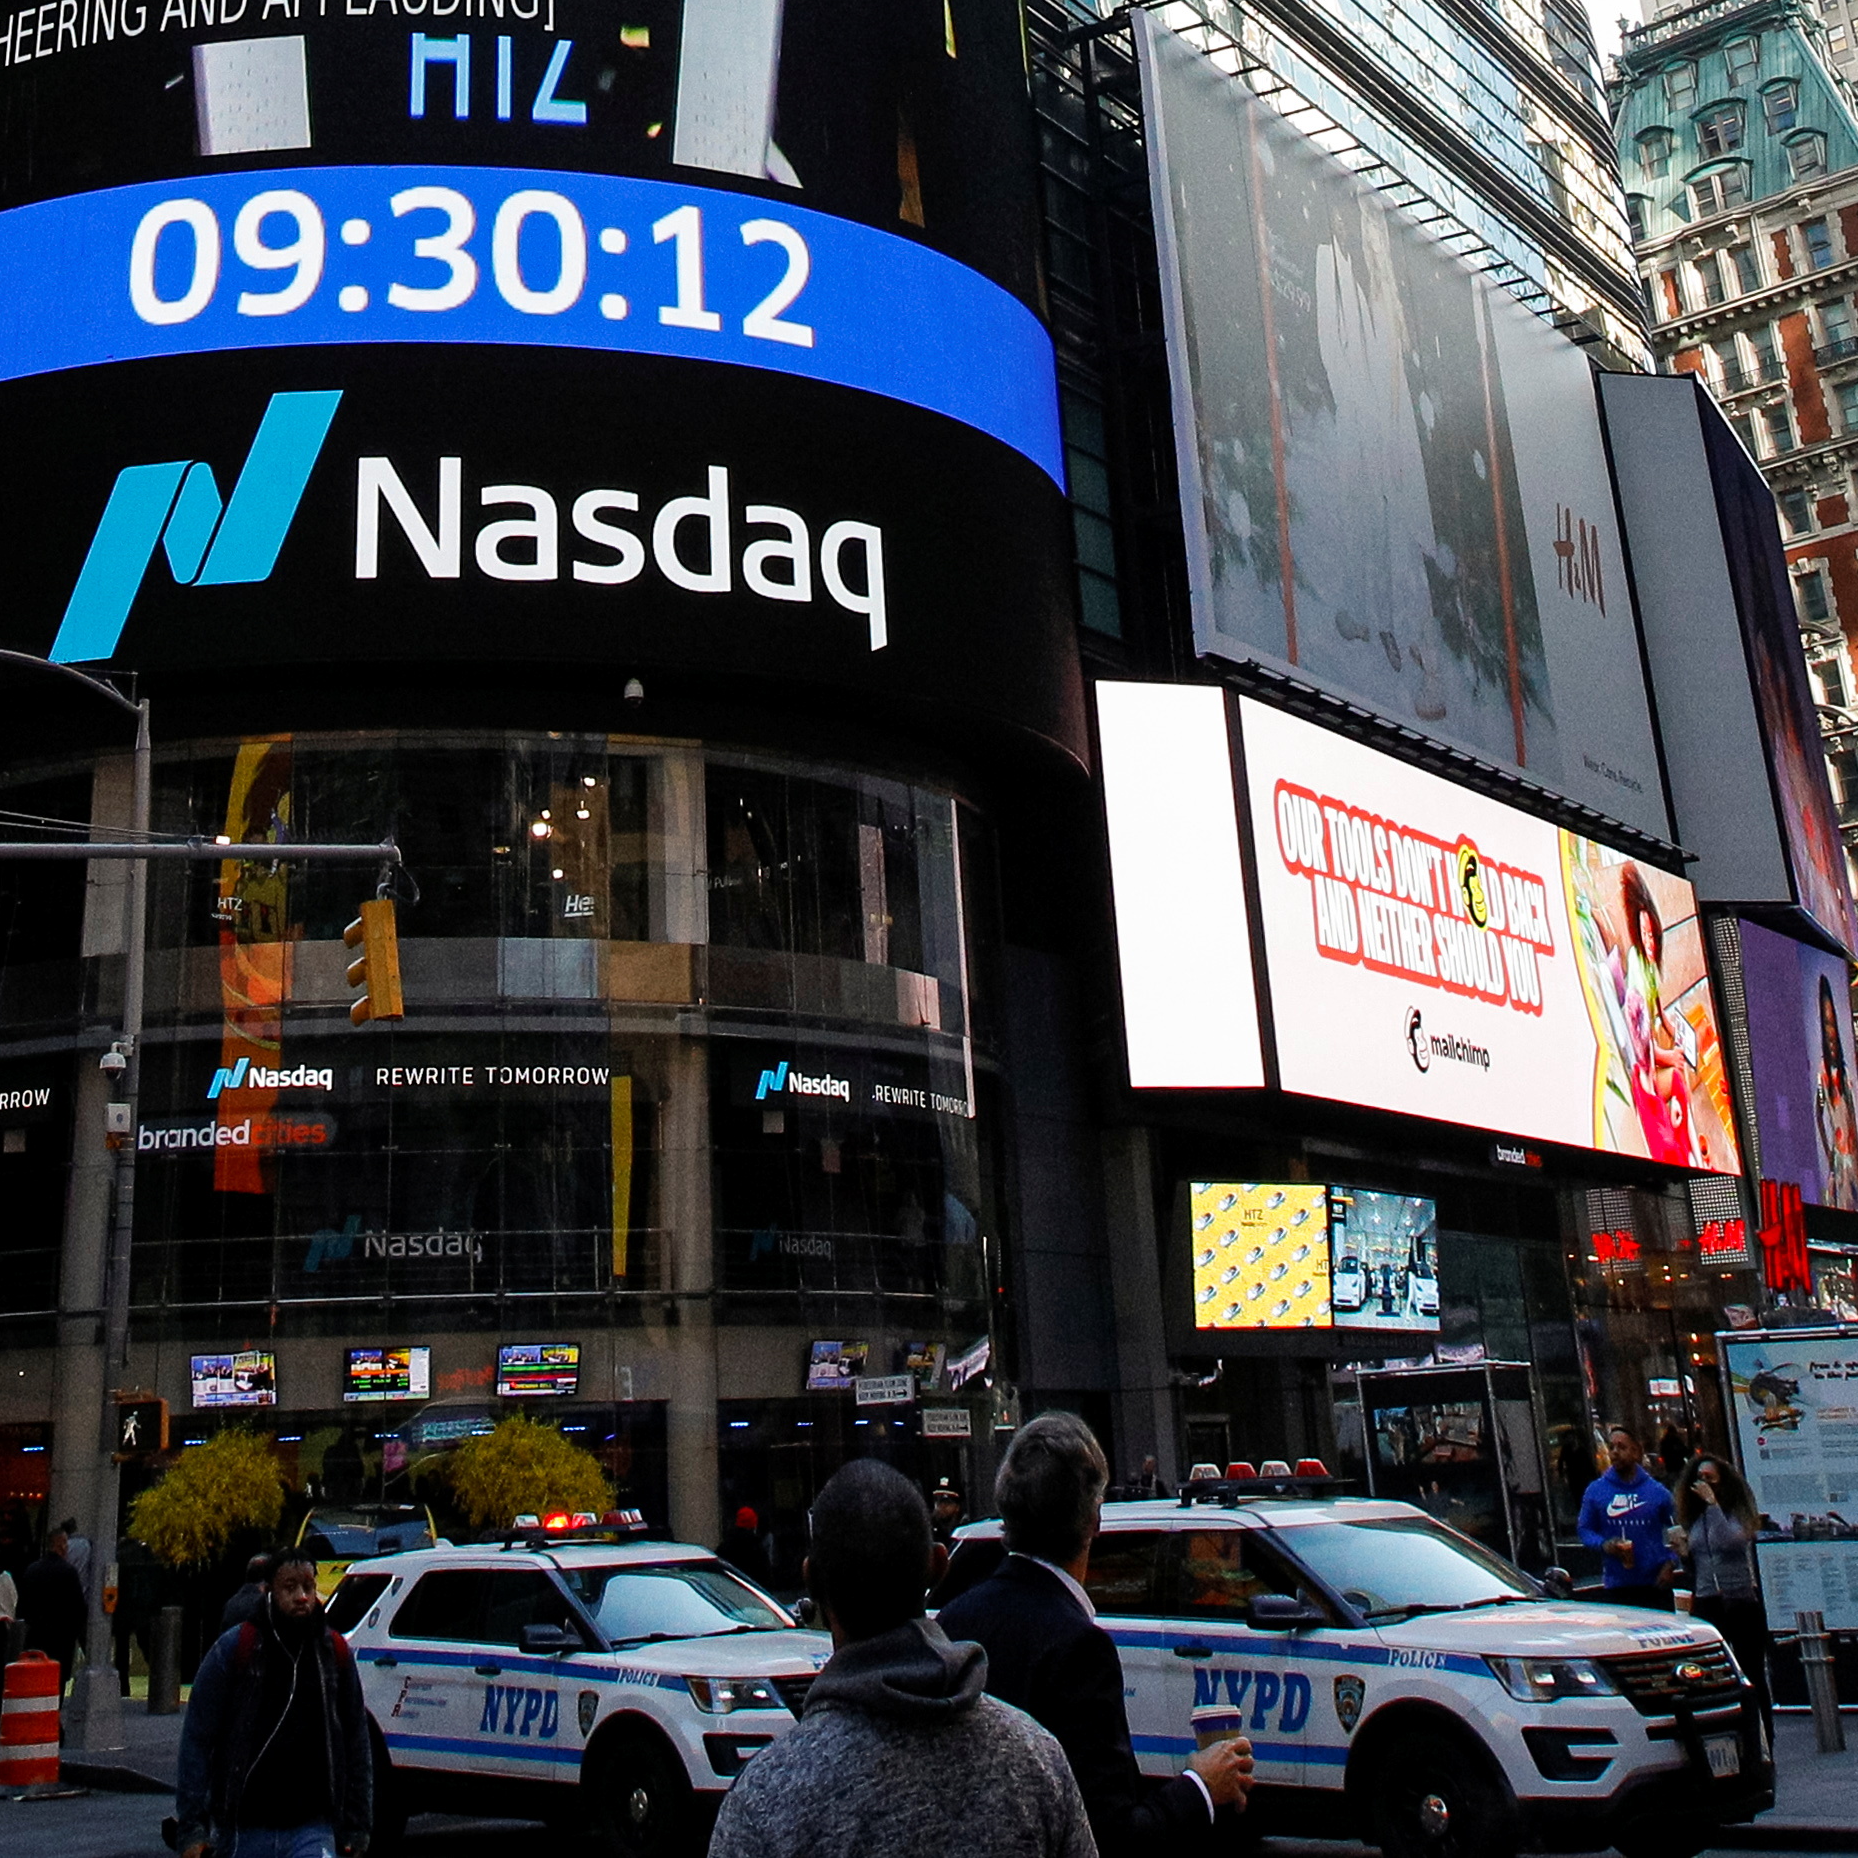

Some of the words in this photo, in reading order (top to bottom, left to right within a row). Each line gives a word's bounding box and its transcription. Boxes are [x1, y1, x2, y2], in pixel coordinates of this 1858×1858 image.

[127, 186, 814, 348] 09:30:12
[355, 456, 887, 652] Nasdaq
[1553, 502, 1606, 619] H&M
[1278, 789, 1329, 873] OUR
[1323, 805, 1393, 894] TOOLS
[1389, 829, 1448, 912] DON'T
[1502, 871, 1552, 947] BACK
[1313, 875, 1359, 954] AND
[1356, 887, 1438, 978] NEITHER
[1433, 913, 1506, 996] SHOULD
[1500, 935, 1541, 1006] YOU
[1430, 1034, 1490, 1072] mailchimp
[248, 1065, 333, 1092] Nasdaq
[376, 1066, 474, 1086] REWRITE
[485, 1066, 610, 1086] TOMORROW
[789, 1071, 850, 1103] Nasdaq
[875, 1083, 927, 1109] REWRITE
[1244, 1209, 1263, 1220] HTZ
[364, 1226, 483, 1263] Nasdaq
[619, 1668, 659, 1687] POLICE
[1389, 1648, 1446, 1669] POLICE
[480, 1684, 559, 1739] NYPD
[1194, 1667, 1312, 1734] NYPD
